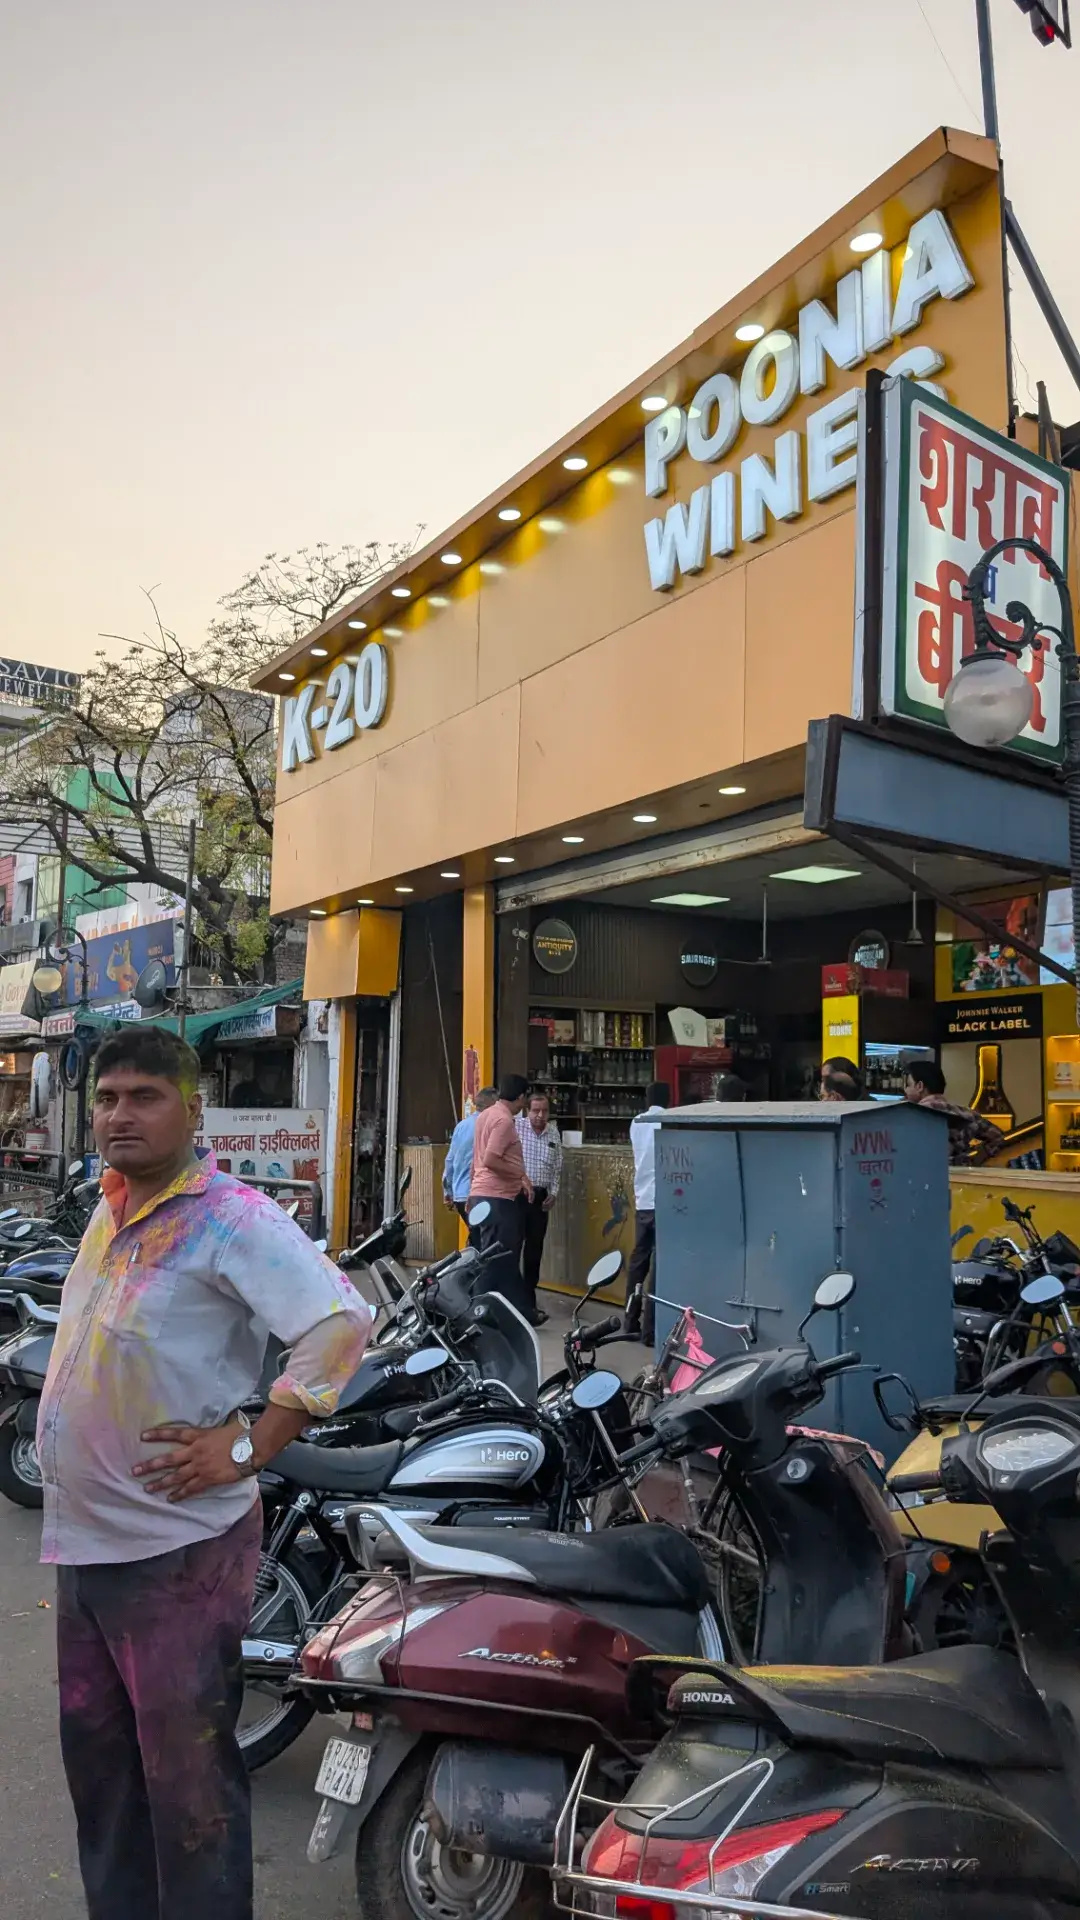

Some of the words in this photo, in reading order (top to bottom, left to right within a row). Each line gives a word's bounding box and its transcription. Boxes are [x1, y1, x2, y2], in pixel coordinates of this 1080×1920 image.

[644, 208, 975, 498] POONIA
[918, 410, 1058, 582] शराब
[282, 642, 389, 773] K-20
[537, 941, 573, 951] ANTIQUITY
[681, 954, 716, 967] SMIRNOFF
[948, 1021, 988, 1033] BLACK
[990, 1019, 1031, 1031] LABEL
[962, 1277, 983, 1286] Hero
[496, 1450, 529, 1461] Hero
[682, 1692, 736, 1705] HONDA
